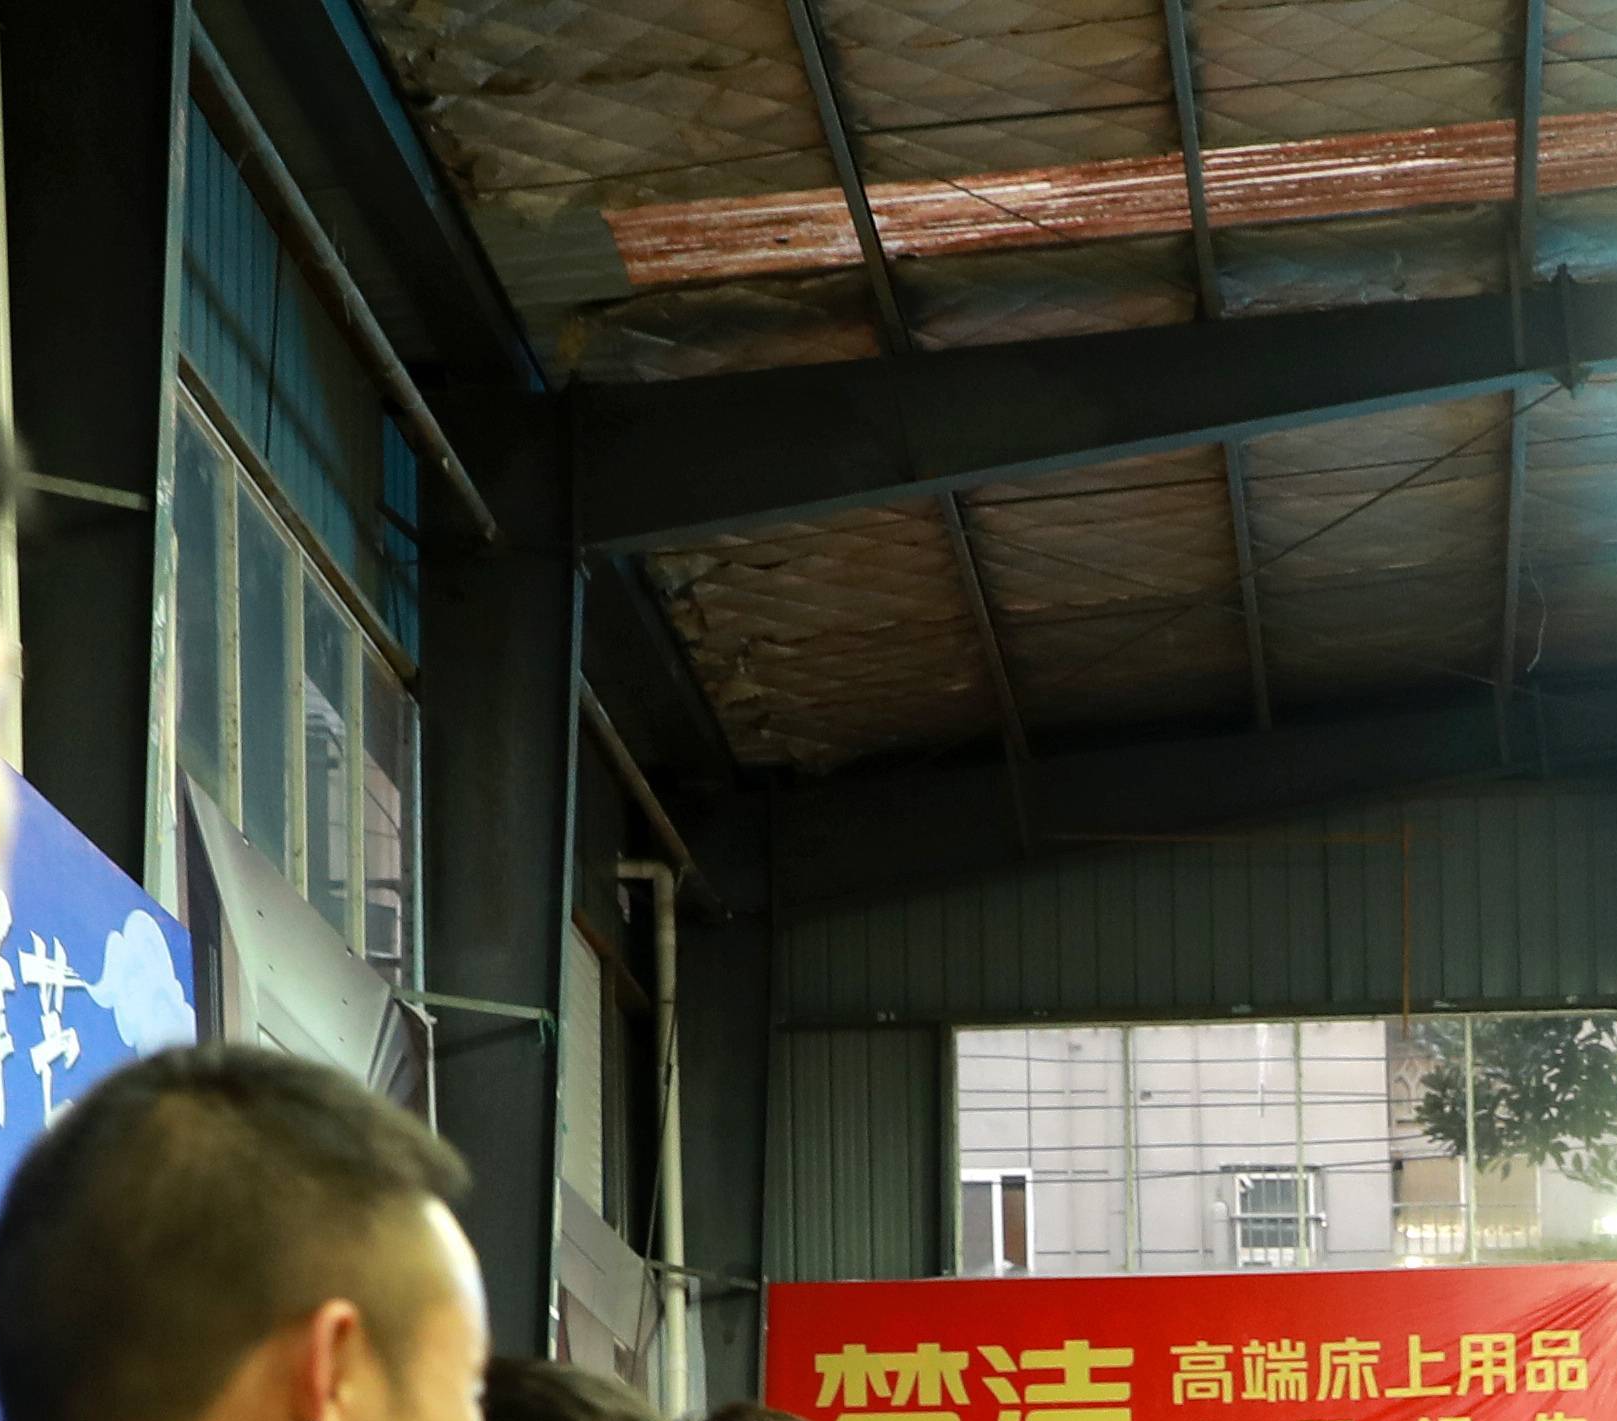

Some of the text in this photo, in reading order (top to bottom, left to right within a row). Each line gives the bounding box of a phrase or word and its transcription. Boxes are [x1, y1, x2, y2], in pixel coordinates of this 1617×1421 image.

[1169, 1329, 1589, 1405] 高端床上用品
